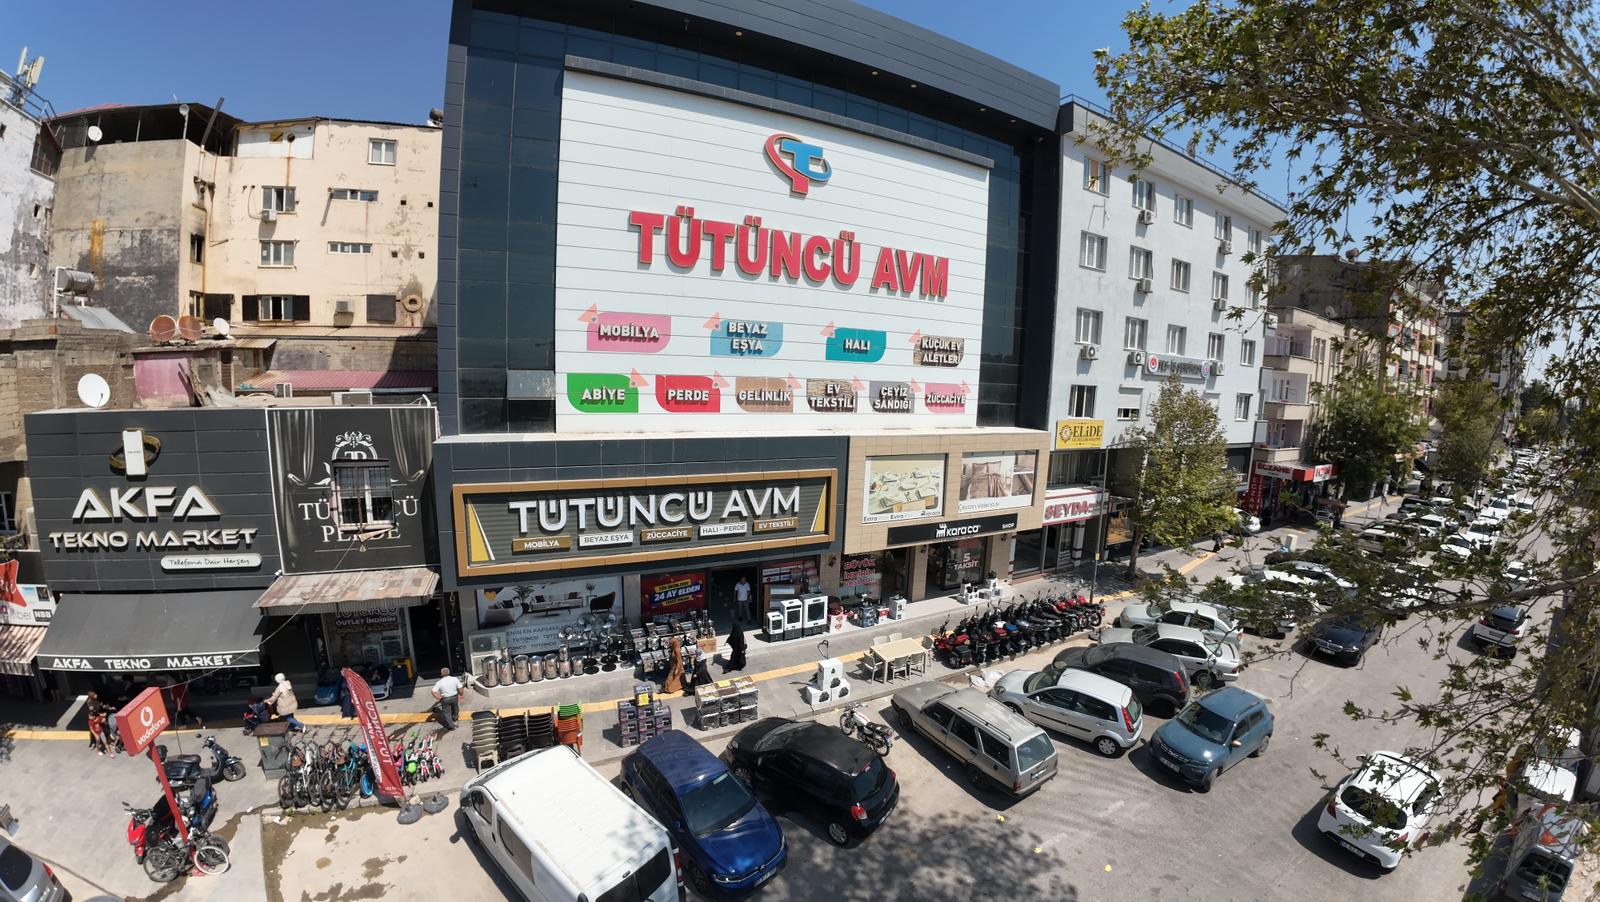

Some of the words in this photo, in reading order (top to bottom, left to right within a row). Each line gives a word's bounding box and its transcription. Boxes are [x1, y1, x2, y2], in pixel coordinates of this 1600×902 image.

[629, 205, 861, 286] TÜTÜNCÜ
[871, 247, 949, 299] AVM
[599, 322, 660, 340] MOBİLYA
[729, 322, 768, 335] BEYAZ
[732, 339, 763, 352] EŞYA
[845, 339, 870, 351] HALI
[922, 337, 949, 351] KÜÇÜK
[922, 352, 961, 364] ALETLERİ
[581, 386, 626, 401] ABİYE
[668, 389, 710, 402] PERDE
[738, 388, 791, 402] GELİNLİK
[827, 384, 841, 394] EV
[881, 386, 908, 399] ÇEYİZ
[810, 396, 857, 408] TEKSTİLİ
[874, 397, 912, 410] SANDIĞI
[927, 392, 966, 404] ZÜCCACİYE
[72, 485, 221, 519] AKFA
[509, 491, 713, 533] TÜTÜNCÜ
[721, 486, 800, 519] AVM
[724, 524, 746, 533] PERDE
[768, 520, 794, 528] TEKSTİLİ
[646, 530, 688, 539] ZÜCCACİYE
[946, 525, 979, 537] karaca
[49, 531, 128, 548] TEKNO
[136, 528, 258, 547] MARKET
[524, 540, 560, 549] MOBİLYA
[584, 535, 609, 543] BEYAZ
[610, 534, 629, 542] EŞYA
[963, 552, 970, 562] 5
[953, 560, 979, 571] TAKSİT
[654, 593, 665, 602] 24
[666, 590, 678, 599] AY
[678, 584, 701, 596] ELDEN
[52, 658, 93, 669] AKFA
[104, 658, 150, 669] TEKNO
[166, 655, 232, 667] MARKET
[138, 716, 166, 745] vodafone
